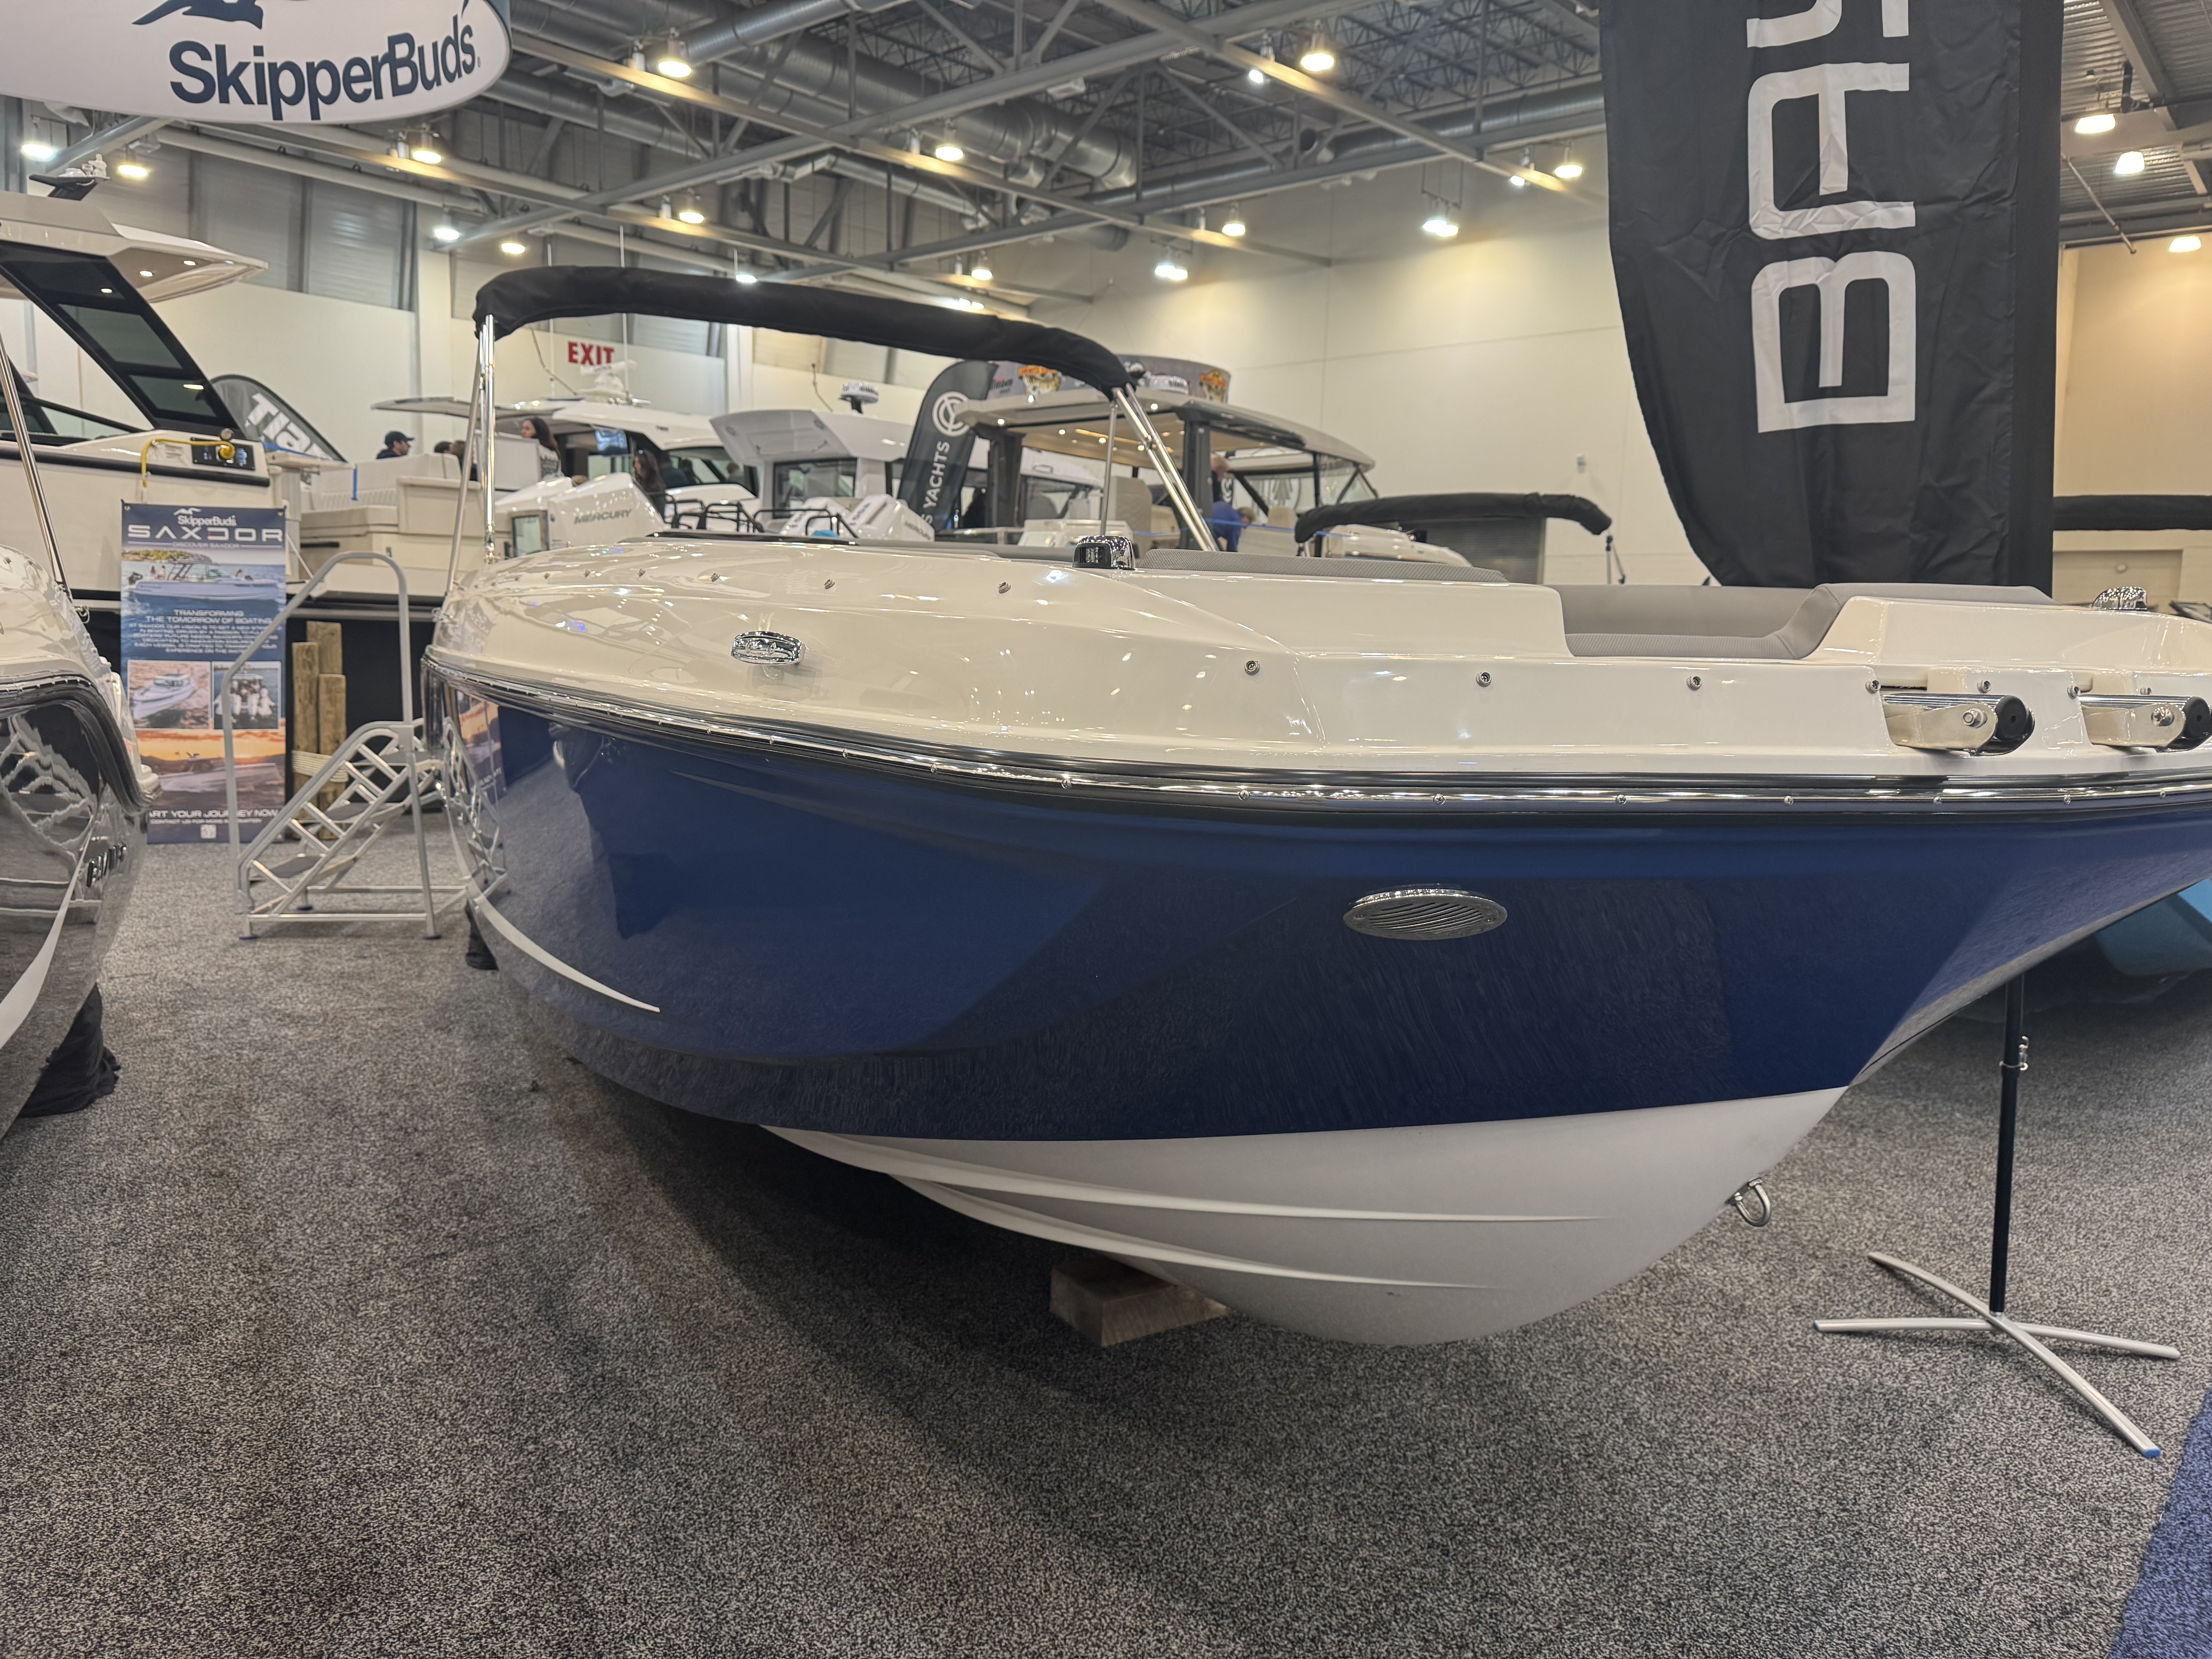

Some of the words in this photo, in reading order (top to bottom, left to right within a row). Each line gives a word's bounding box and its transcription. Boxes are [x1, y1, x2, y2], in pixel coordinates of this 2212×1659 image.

[1746, 0, 1916, 433] BA
[568, 342, 614, 365] EXIT
[923, 441, 950, 508] YACHTS
[574, 509, 632, 525] MERCURY
[173, 609, 244, 617] TRANSFORMING
